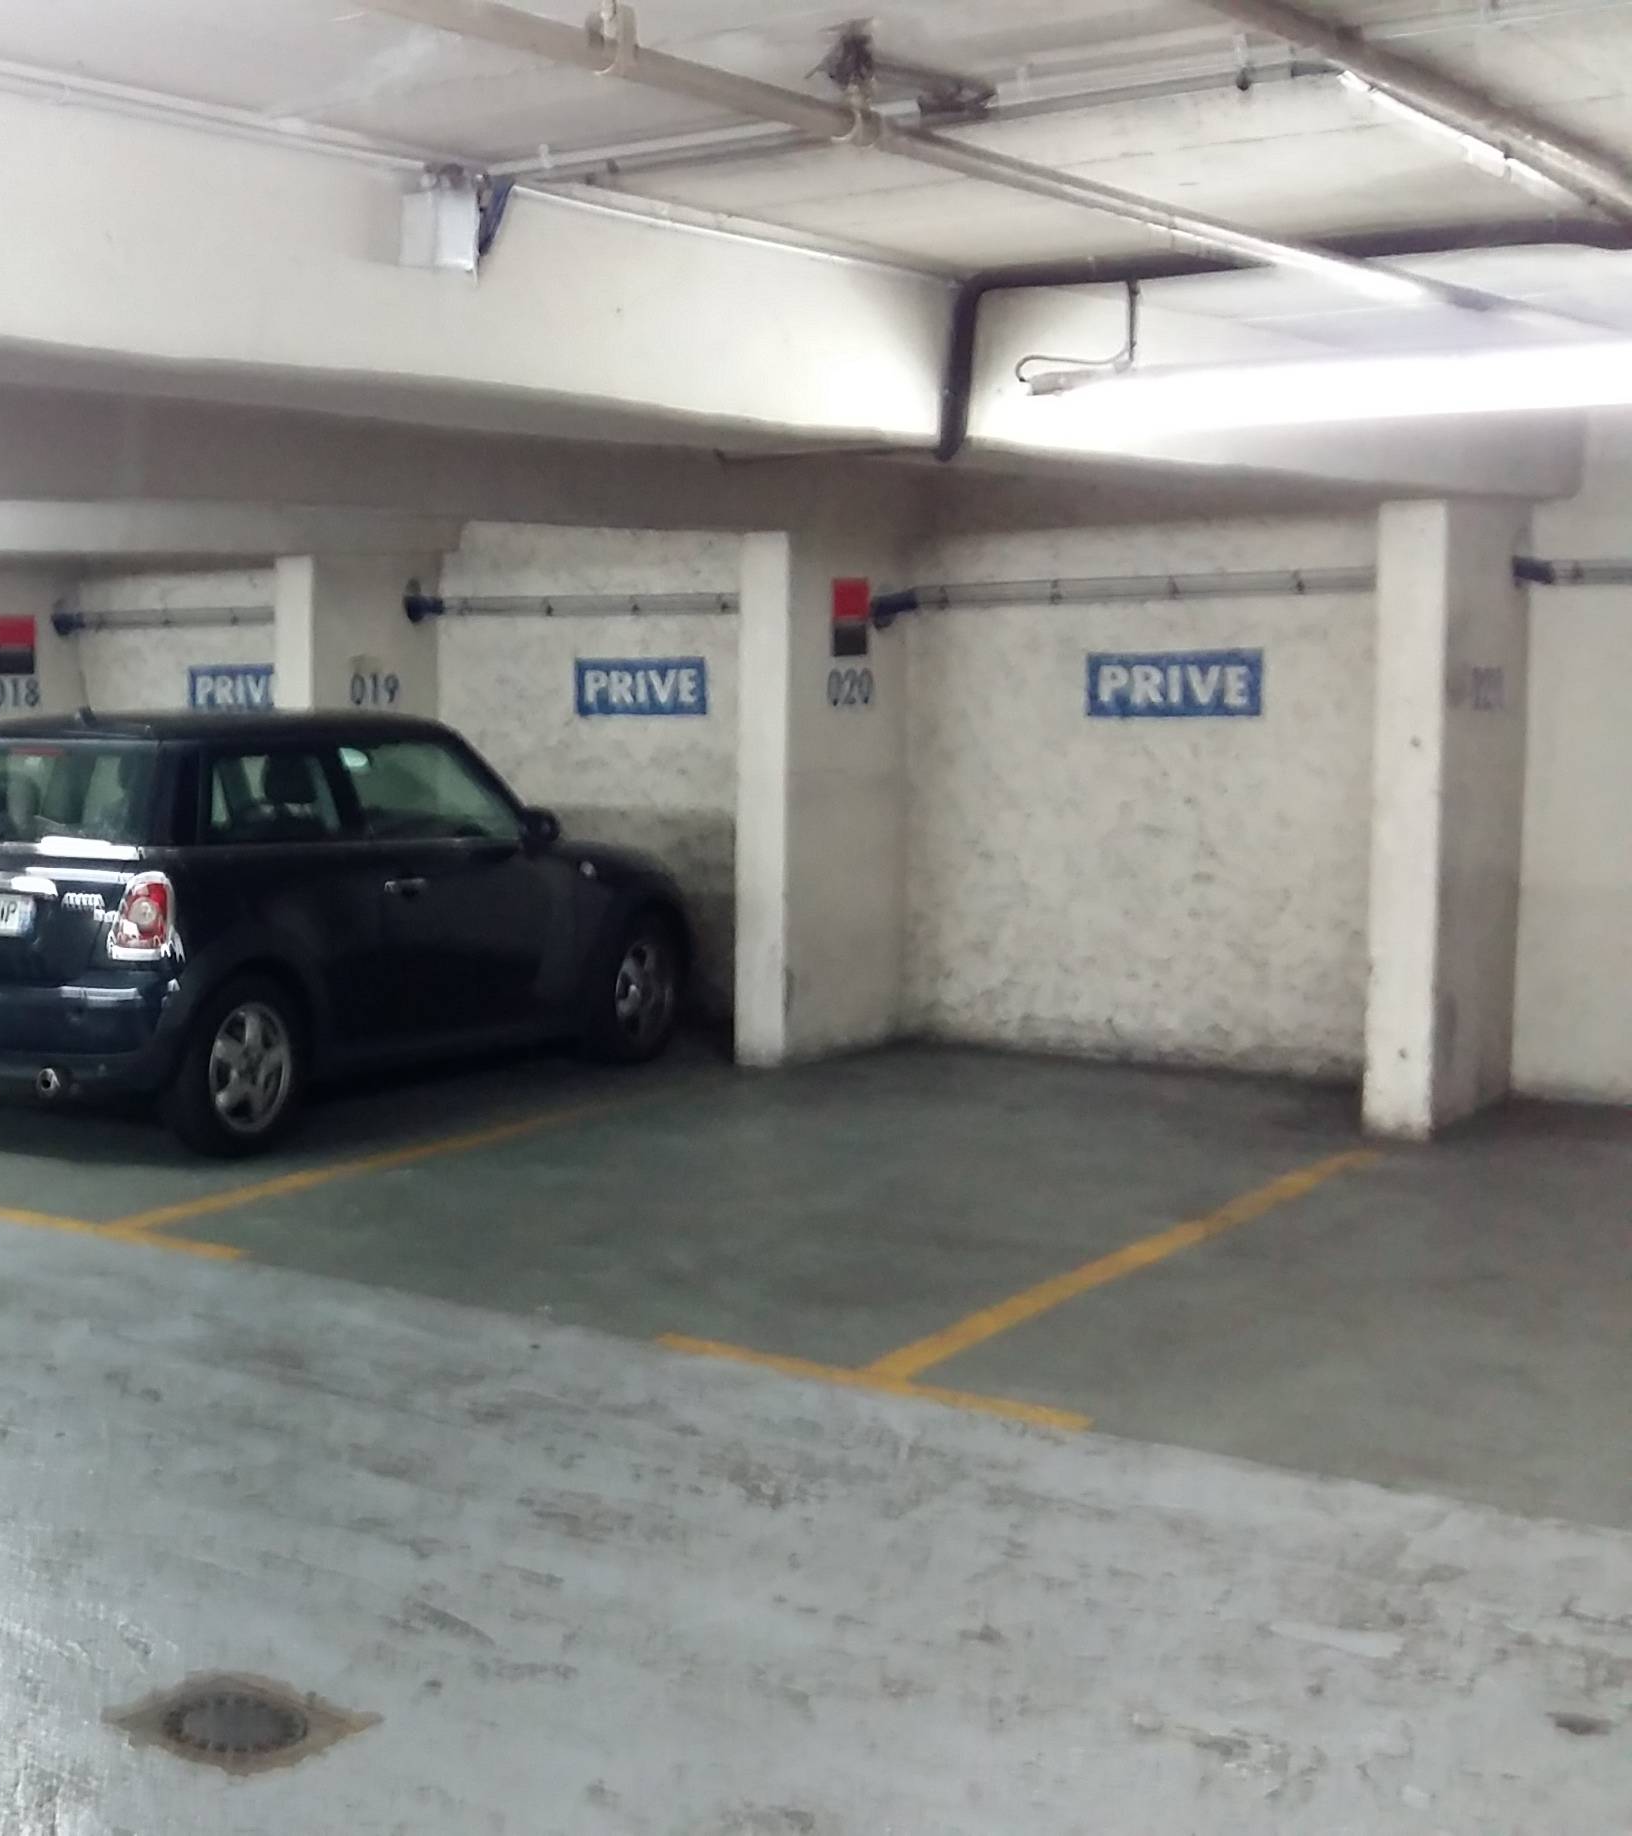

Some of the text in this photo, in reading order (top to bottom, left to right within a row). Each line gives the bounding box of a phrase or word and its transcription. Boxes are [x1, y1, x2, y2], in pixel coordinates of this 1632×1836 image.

[195, 674, 272, 705] PRIV
[350, 672, 400, 706] 019
[583, 668, 698, 704] PRIVE
[827, 667, 875, 706] 020
[1097, 663, 1251, 706] PRIVE
